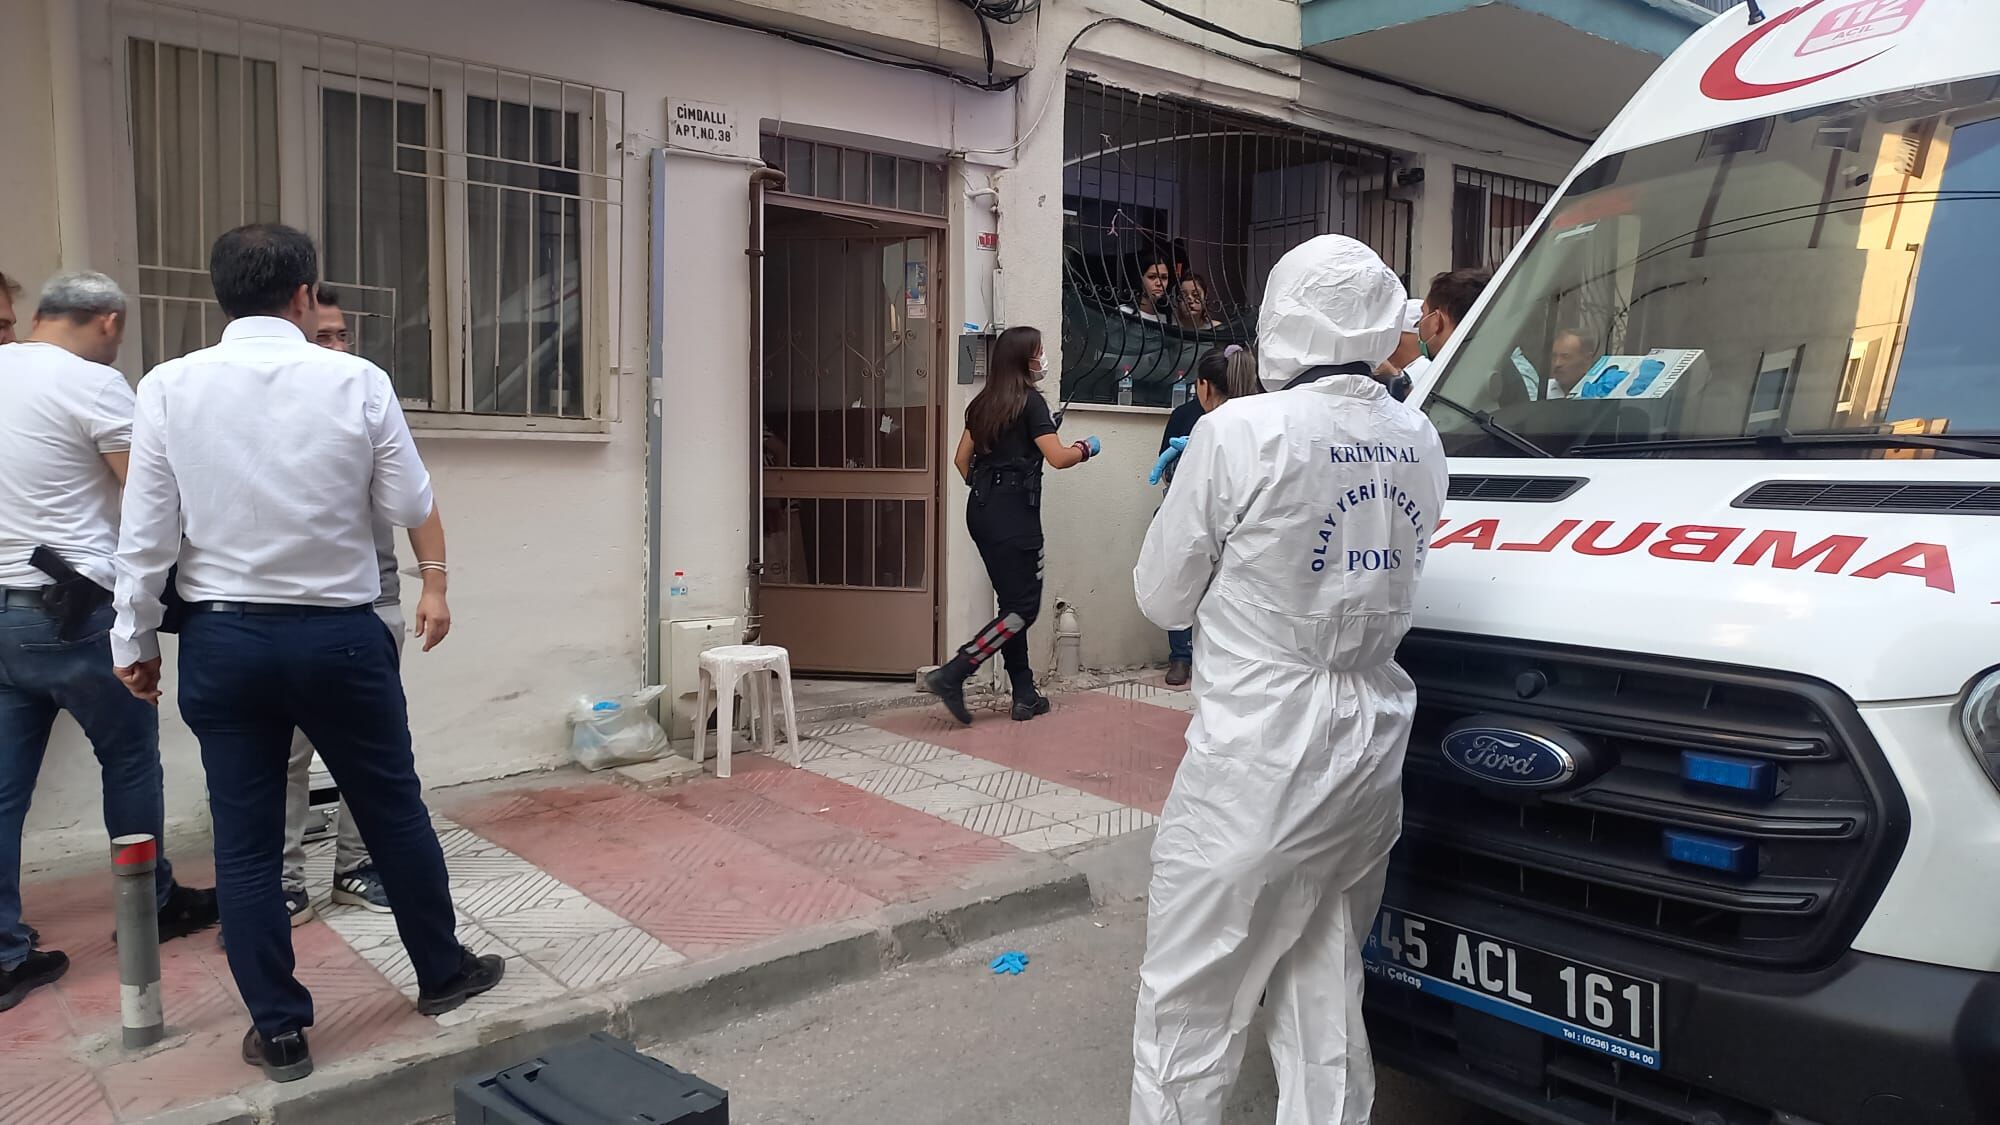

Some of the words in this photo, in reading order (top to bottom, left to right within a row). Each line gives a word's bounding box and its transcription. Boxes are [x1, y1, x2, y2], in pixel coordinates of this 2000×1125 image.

[1329, 441, 1420, 464] KRİMİNAL
[1311, 512, 1337, 573] OLAY
[1336, 478, 1376, 513] YERİ
[1464, 734, 1538, 775] Ford
[1380, 911, 1429, 969] 45
[1451, 933, 1533, 1004] ACL
[1559, 966, 1641, 1039] 161
[1562, 1028, 1575, 1039] Tel
[1582, 1034, 1609, 1051] (0236)
[1611, 1044, 1627, 1056] 233
[1629, 1050, 1640, 1060] 84
[1642, 1054, 1654, 1064] 00
